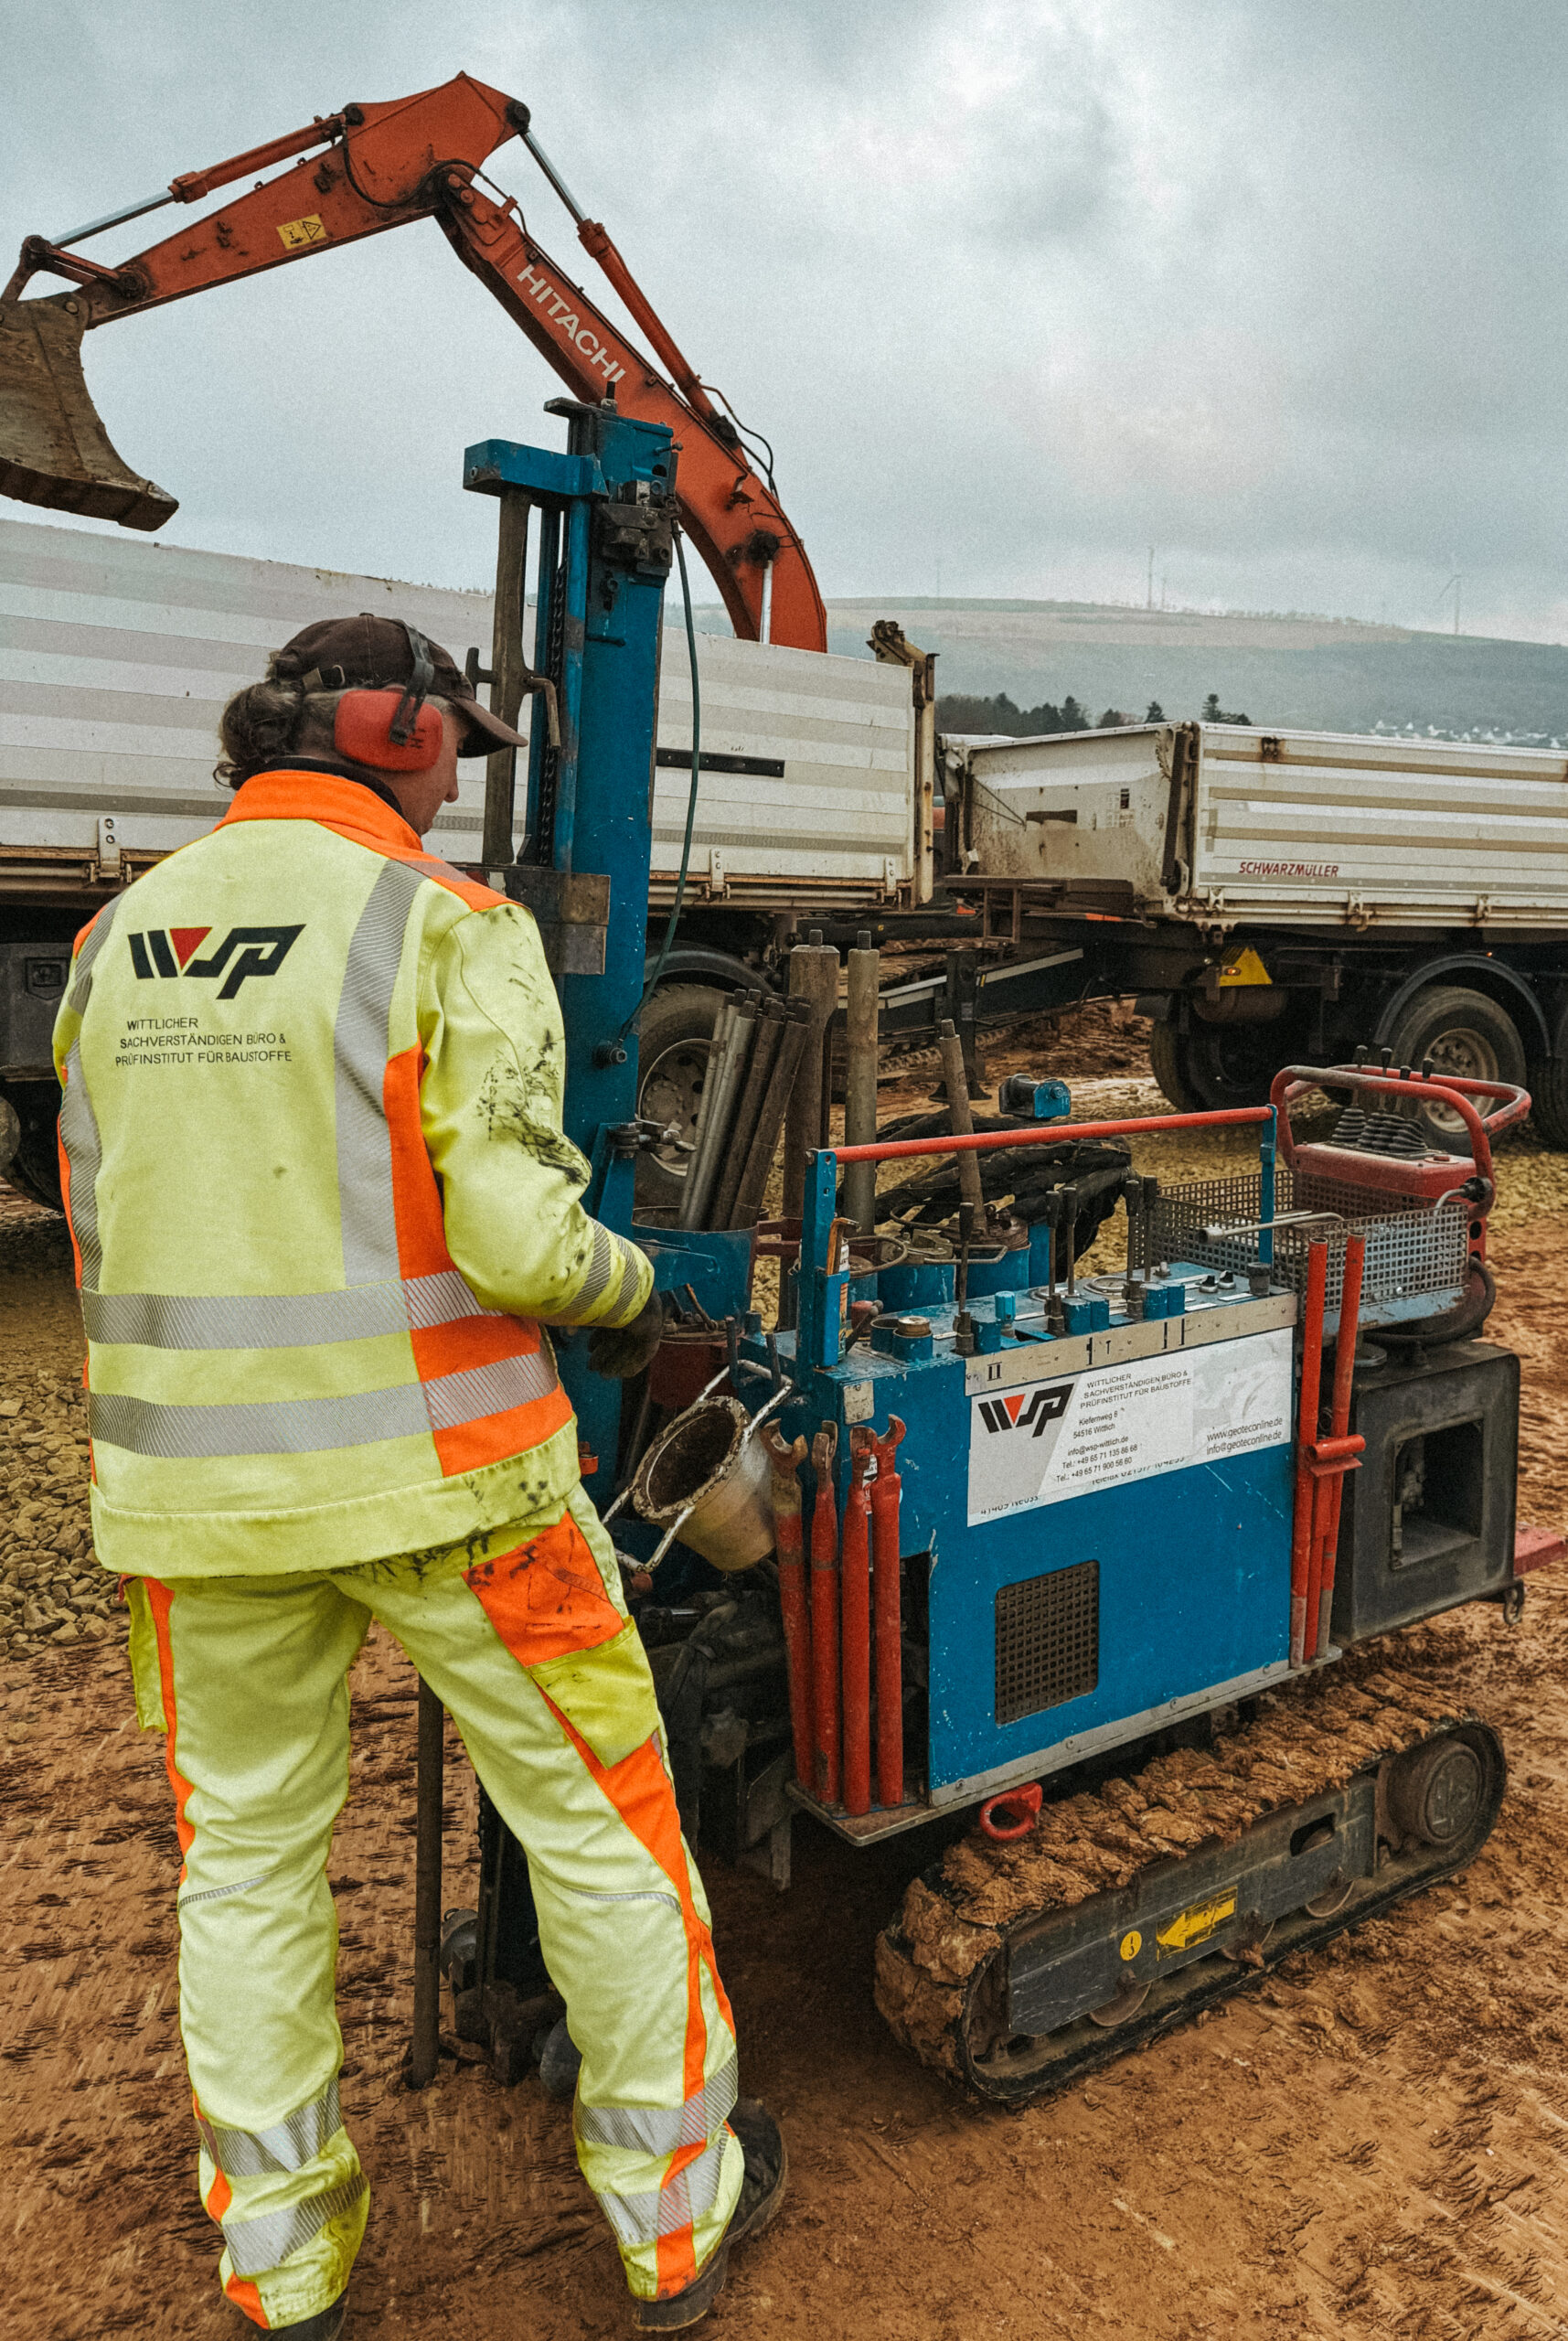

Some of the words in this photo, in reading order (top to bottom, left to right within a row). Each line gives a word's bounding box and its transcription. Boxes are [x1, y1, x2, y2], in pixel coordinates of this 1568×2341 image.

[517, 264, 626, 383] HITACHI
[1239, 861, 1339, 877] SCHWARZMÜLLER
[127, 1018, 198, 1031] WITTLICHER
[120, 1033, 243, 1049] SACHVERSTÄNDIGEN
[246, 1032, 276, 1045] BÜRO
[279, 1033, 286, 1044] &
[115, 1052, 194, 1067] PRÜFINSTITUT
[197, 1051, 223, 1064] FÜR
[226, 1051, 293, 1063] BAUSTOFFE
[1083, 1376, 1160, 1398] SACHVERSTÄNDIGEN
[1161, 1372, 1181, 1382] BÜRO
[1087, 1374, 1132, 1388] WITTLICHER
[1080, 1391, 1133, 1409] PRÜFINSTITUT
[1134, 1386, 1149, 1396] FÜR
[1150, 1378, 1192, 1393] BAUSTOFFE
[1079, 1413, 1113, 1426] Kiefernweg
[1207, 1416, 1283, 1442] www.geoteconline.de
[1072, 1427, 1093, 1438] 54516
[1093, 1422, 1115, 1434] Wittlich
[1068, 1436, 1128, 1456] info@wsp-wittlich.de
[1206, 1430, 1282, 1455] info@geoteconline.de
[1062, 1460, 1075, 1469] Tel.:
[1077, 1456, 1089, 1464] +49
[1090, 1454, 1098, 1462] 65
[1109, 1448, 1120, 1457] 135
[1056, 1472, 1070, 1482] Tel.:
[1072, 1469, 1083, 1477] +49
[1083, 1467, 1093, 1475] 65
[1093, 1464, 1101, 1472] 71
[1103, 1461, 1115, 1470] 900
